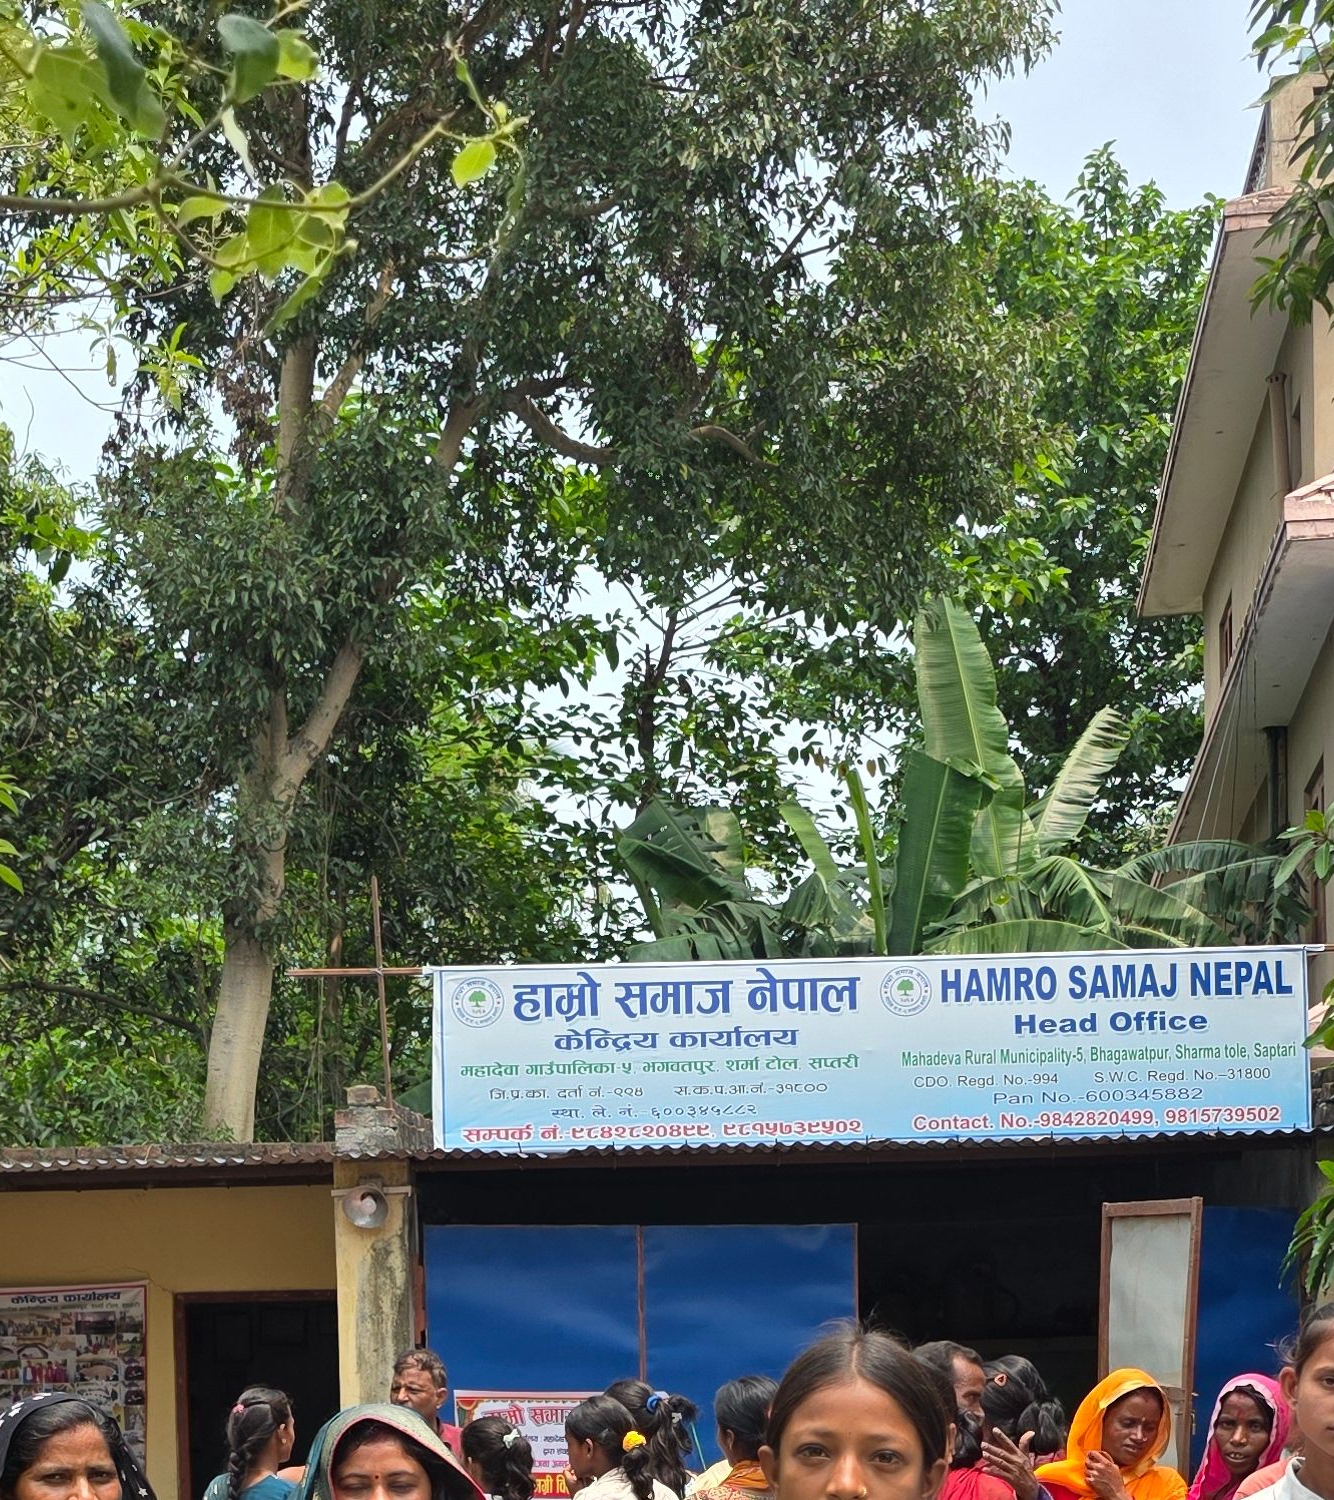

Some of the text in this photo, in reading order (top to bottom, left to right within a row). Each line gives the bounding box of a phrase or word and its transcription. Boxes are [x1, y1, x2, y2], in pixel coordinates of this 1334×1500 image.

[940, 967, 1057, 1002] HAMRO
[1068, 963, 1178, 999] SAMAJ
[1191, 960, 1293, 996] NEPAL
[513, 971, 601, 1022] हाम्रो
[614, 979, 733, 1018] समाज
[747, 967, 861, 1014] नेपाल
[1014, 1011, 1208, 1036] Head Office
[554, 1025, 799, 1053] केन्द्रिय कार्यालय
[460, 1061, 518, 1077] महादेवा
[725, 1056, 760, 1071] शर्मा
[808, 1053, 859, 1069] सप्तरी
[901, 1041, 1296, 1067] Mahadeva Rural Municipality-5, Bhagawatpur, Sharma tole, Saptari
[913, 1072, 1058, 1088] CDO. Regd. No.-994
[1094, 1070, 1141, 1084] S.W.C.
[1148, 1069, 1188, 1083] Regd.
[557, 1085, 583, 1099] दर्ता
[993, 1087, 1203, 1105] Pan No.-600345882
[913, 1112, 994, 1132] Contact.
[1165, 1106, 1281, 1124] 9815739502
[462, 1124, 533, 1142] सम्पर्क
[528, 1406, 572, 1426] समा
